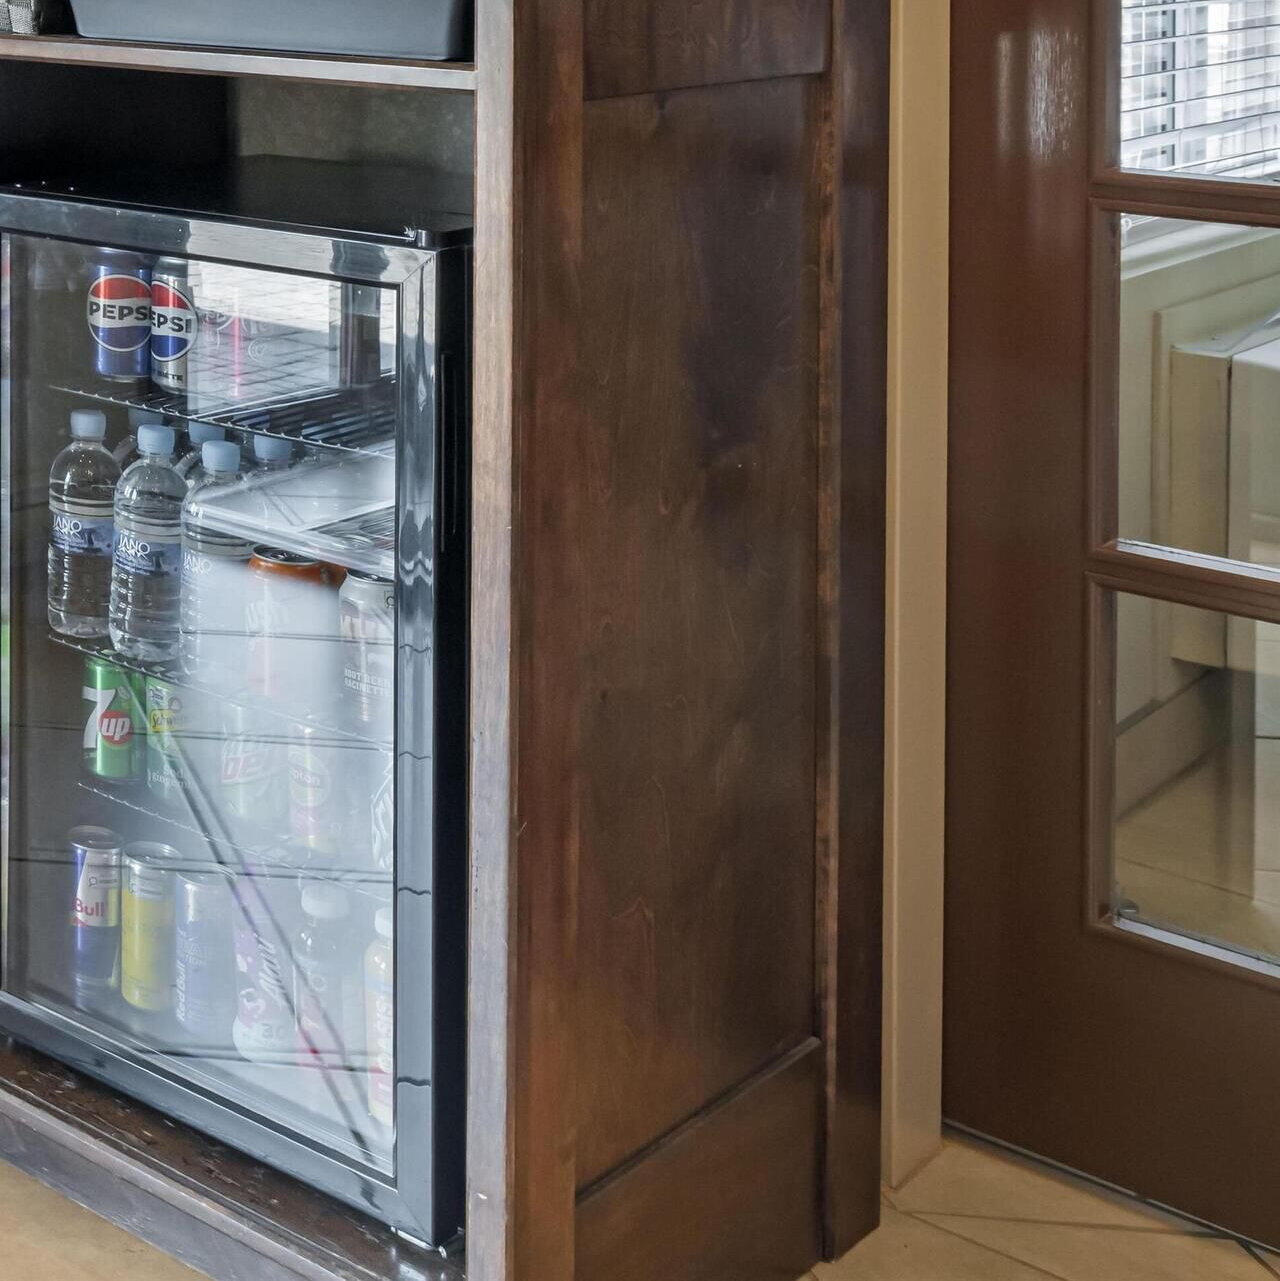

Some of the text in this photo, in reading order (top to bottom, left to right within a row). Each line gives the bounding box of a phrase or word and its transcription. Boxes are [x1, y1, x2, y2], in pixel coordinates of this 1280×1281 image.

[83, 685, 132, 751] 7 up
[74, 898, 105, 918] Bull
